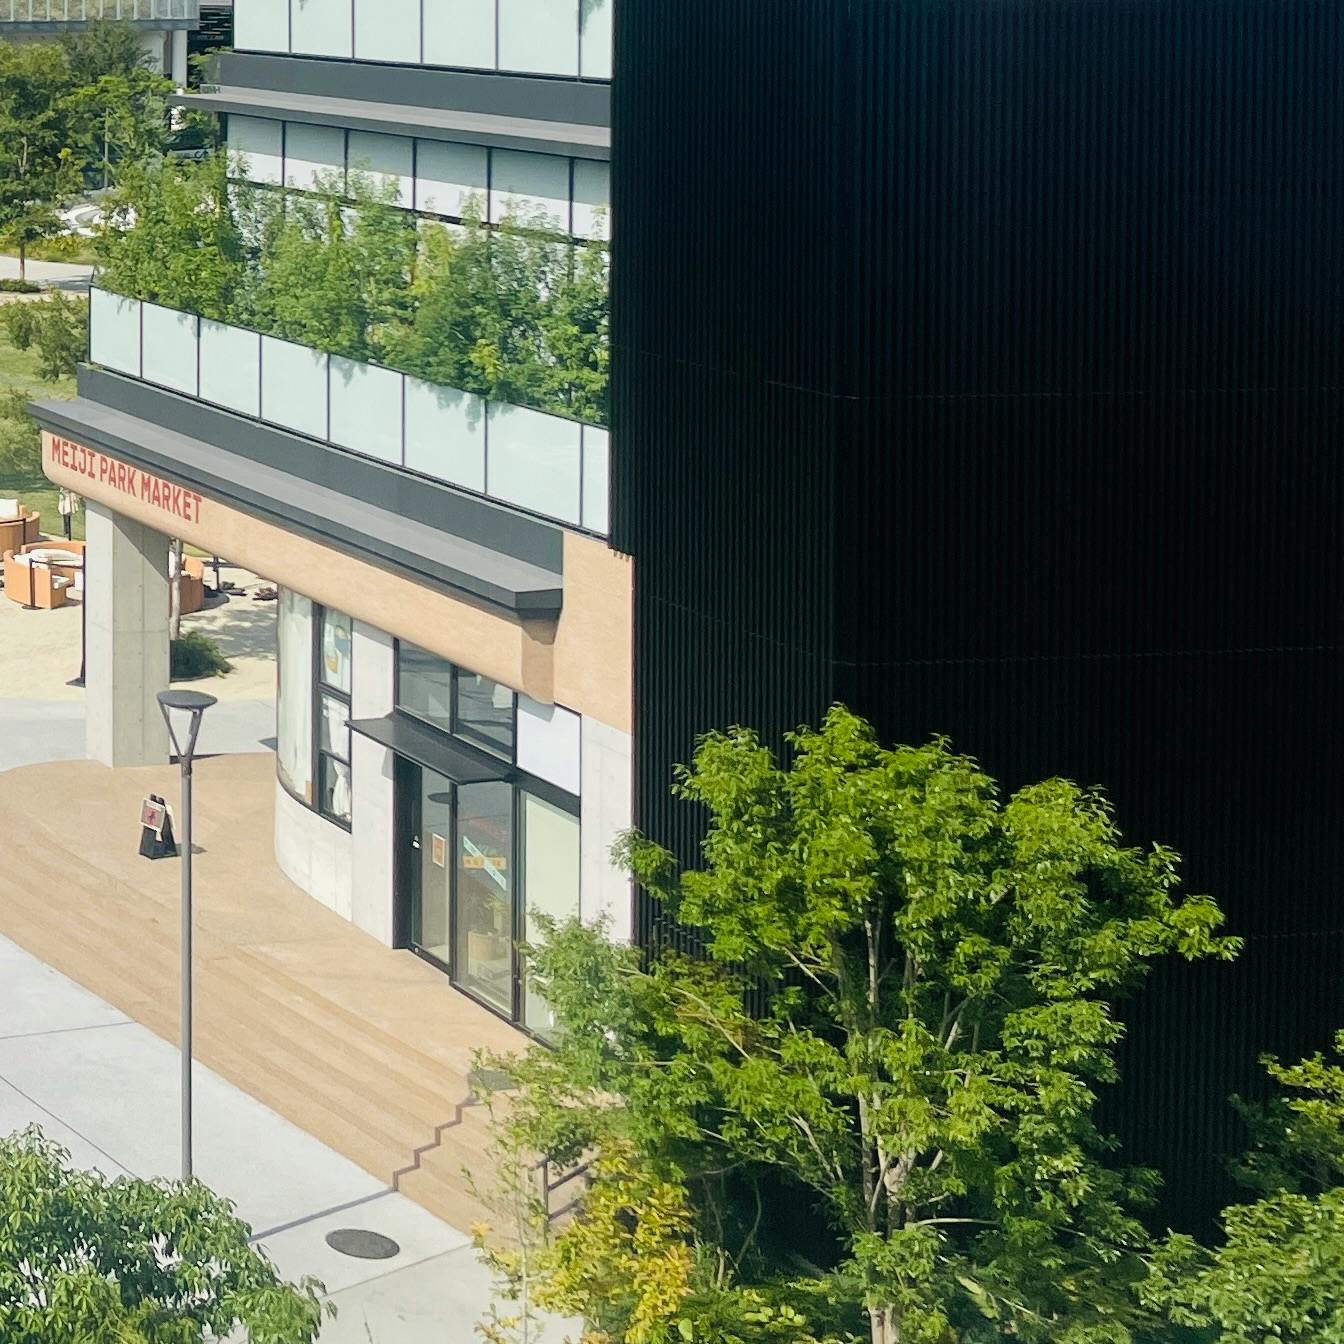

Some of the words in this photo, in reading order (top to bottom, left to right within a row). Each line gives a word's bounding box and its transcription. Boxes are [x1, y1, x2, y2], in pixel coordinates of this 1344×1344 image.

[51, 436, 96, 479] MEIJI
[99, 455, 137, 498] PARK
[141, 471, 202, 524] MARKET
